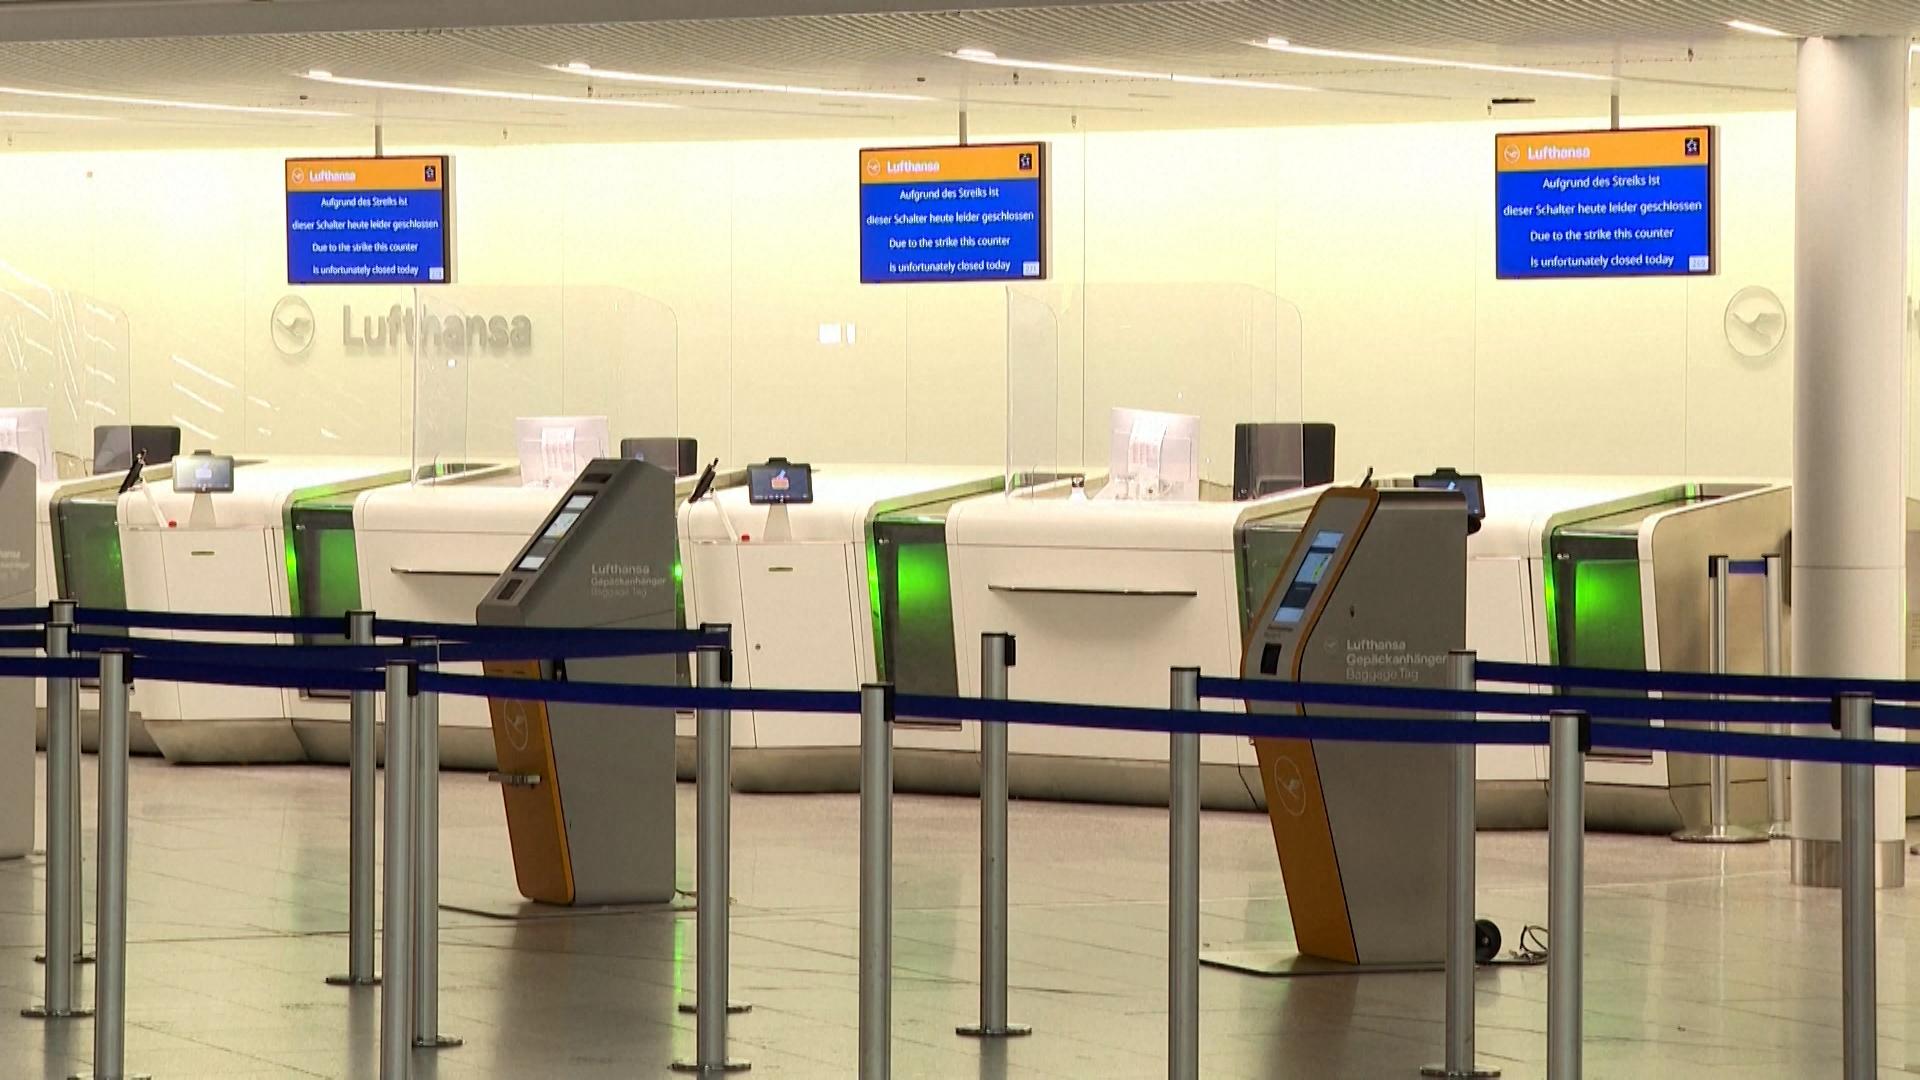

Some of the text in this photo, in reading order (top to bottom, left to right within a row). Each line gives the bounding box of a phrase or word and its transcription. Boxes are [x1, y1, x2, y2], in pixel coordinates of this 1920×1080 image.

[1527, 146, 1590, 160] Lufthansa
[887, 160, 940, 173] Lufthansa
[309, 170, 356, 182] Lufthansa
[1543, 178, 1590, 191] Aufgrund
[1592, 177, 1610, 187] des
[1612, 176, 1646, 186] Streiks
[899, 188, 940, 202] Aufgrund
[942, 188, 957, 198] des
[959, 187, 987, 198] Streiks
[321, 197, 356, 209] Aufgrund
[358, 197, 371, 206] des
[372, 197, 397, 206] Streiks
[1503, 201, 1702, 216] dieser Schalter heute leider geschlossen
[867, 210, 1034, 225] dieser Schalter heute leider geschlossen
[292, 219, 438, 231] dieser Schalter heute leider geschlossen
[1530, 228, 1674, 241] Due to the strike this counter
[312, 242, 418, 252] Due to the strike this counter
[889, 236, 1010, 248] Due to the strike this counter
[898, 262, 956, 274] unfortunately
[957, 261, 984, 271] closed
[986, 261, 1011, 273] today
[1541, 256, 1608, 269] unfortunately
[1611, 255, 1642, 266] closed
[1645, 254, 1674, 268] today
[320, 265, 370, 277] unfortunately
[372, 265, 396, 275] closed
[397, 265, 419, 276] today
[343, 304, 531, 347] Lufthansa
[591, 563, 650, 574] Lufthansa
[1346, 639, 1406, 650] Lufthansa
